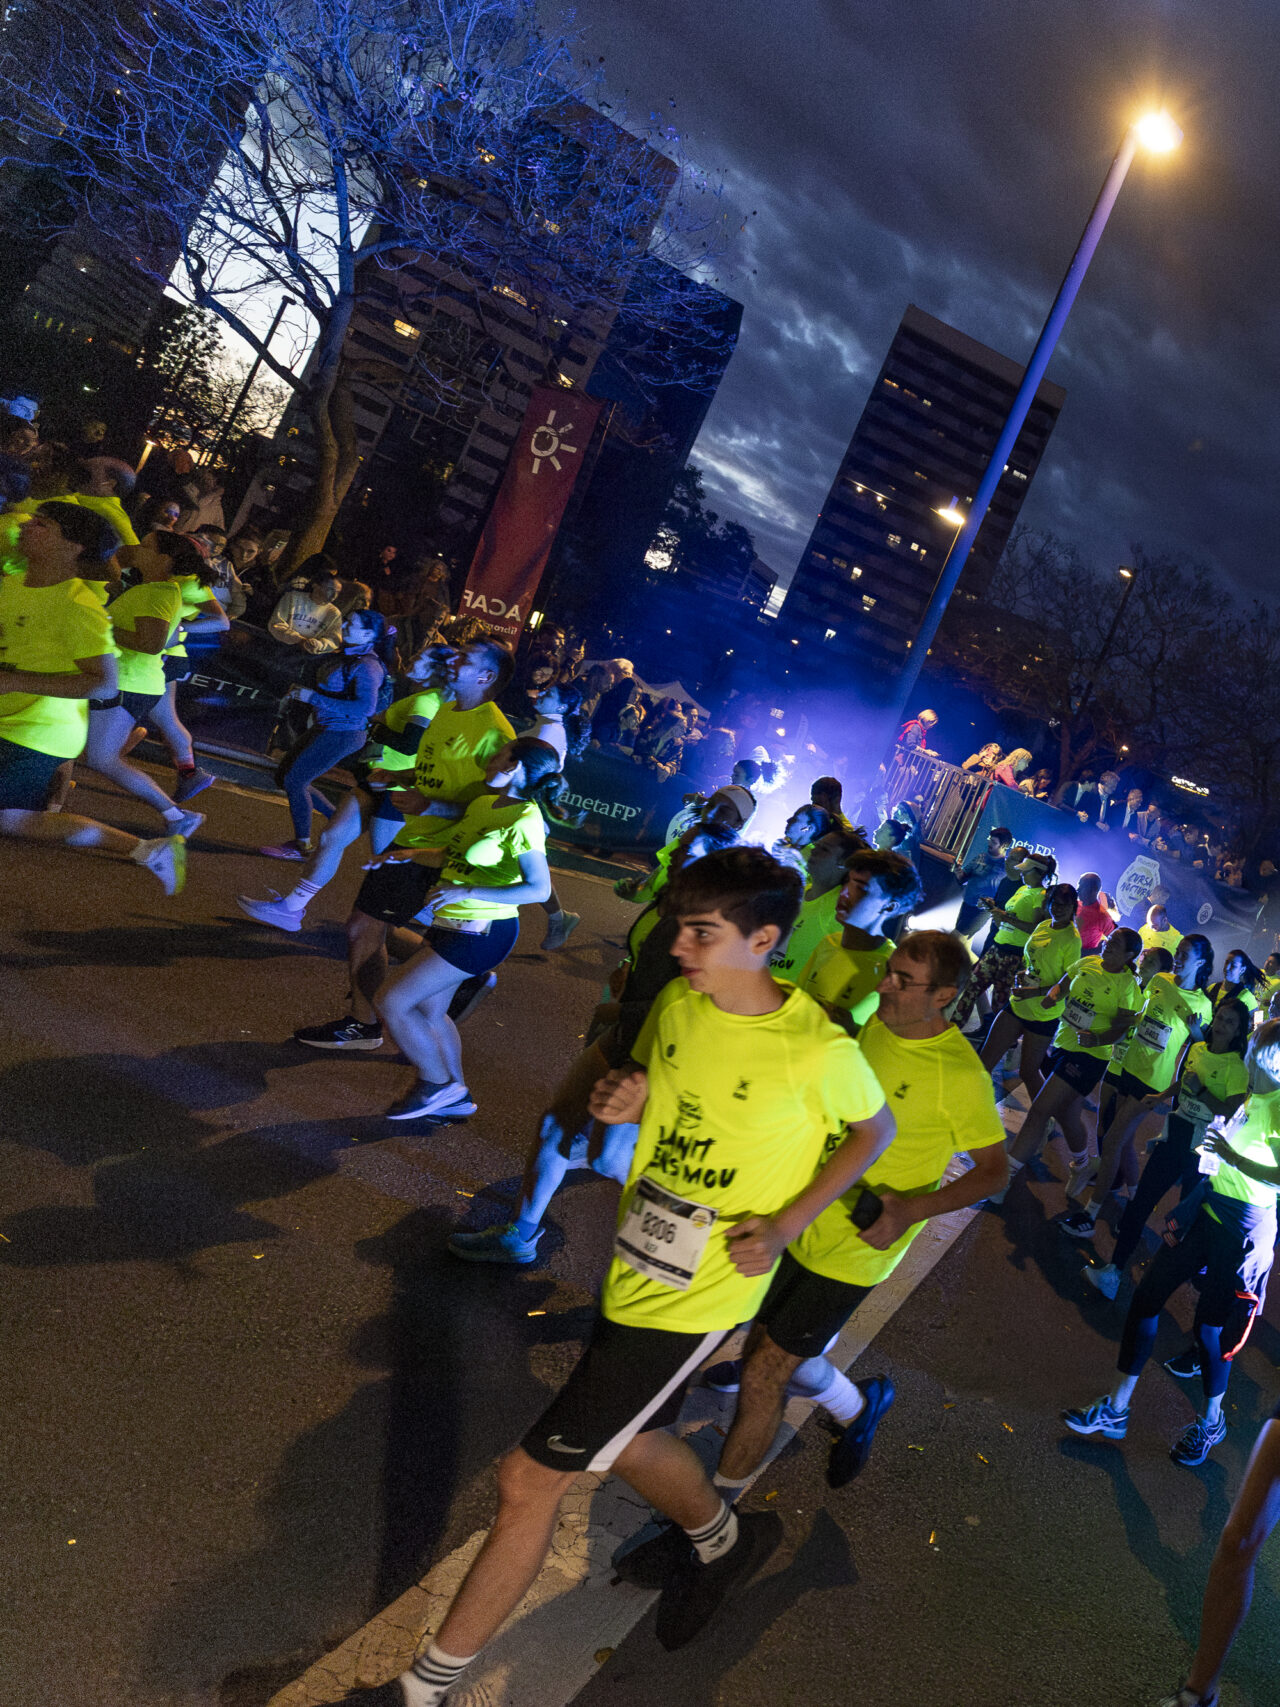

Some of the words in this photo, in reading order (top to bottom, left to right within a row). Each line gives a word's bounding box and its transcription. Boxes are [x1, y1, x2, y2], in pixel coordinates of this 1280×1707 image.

[558, 791, 642, 821] anetaFP
[658, 1125, 677, 1147] LA
[678, 1136, 716, 1162] NIT
[683, 1164, 738, 1189] MOU
